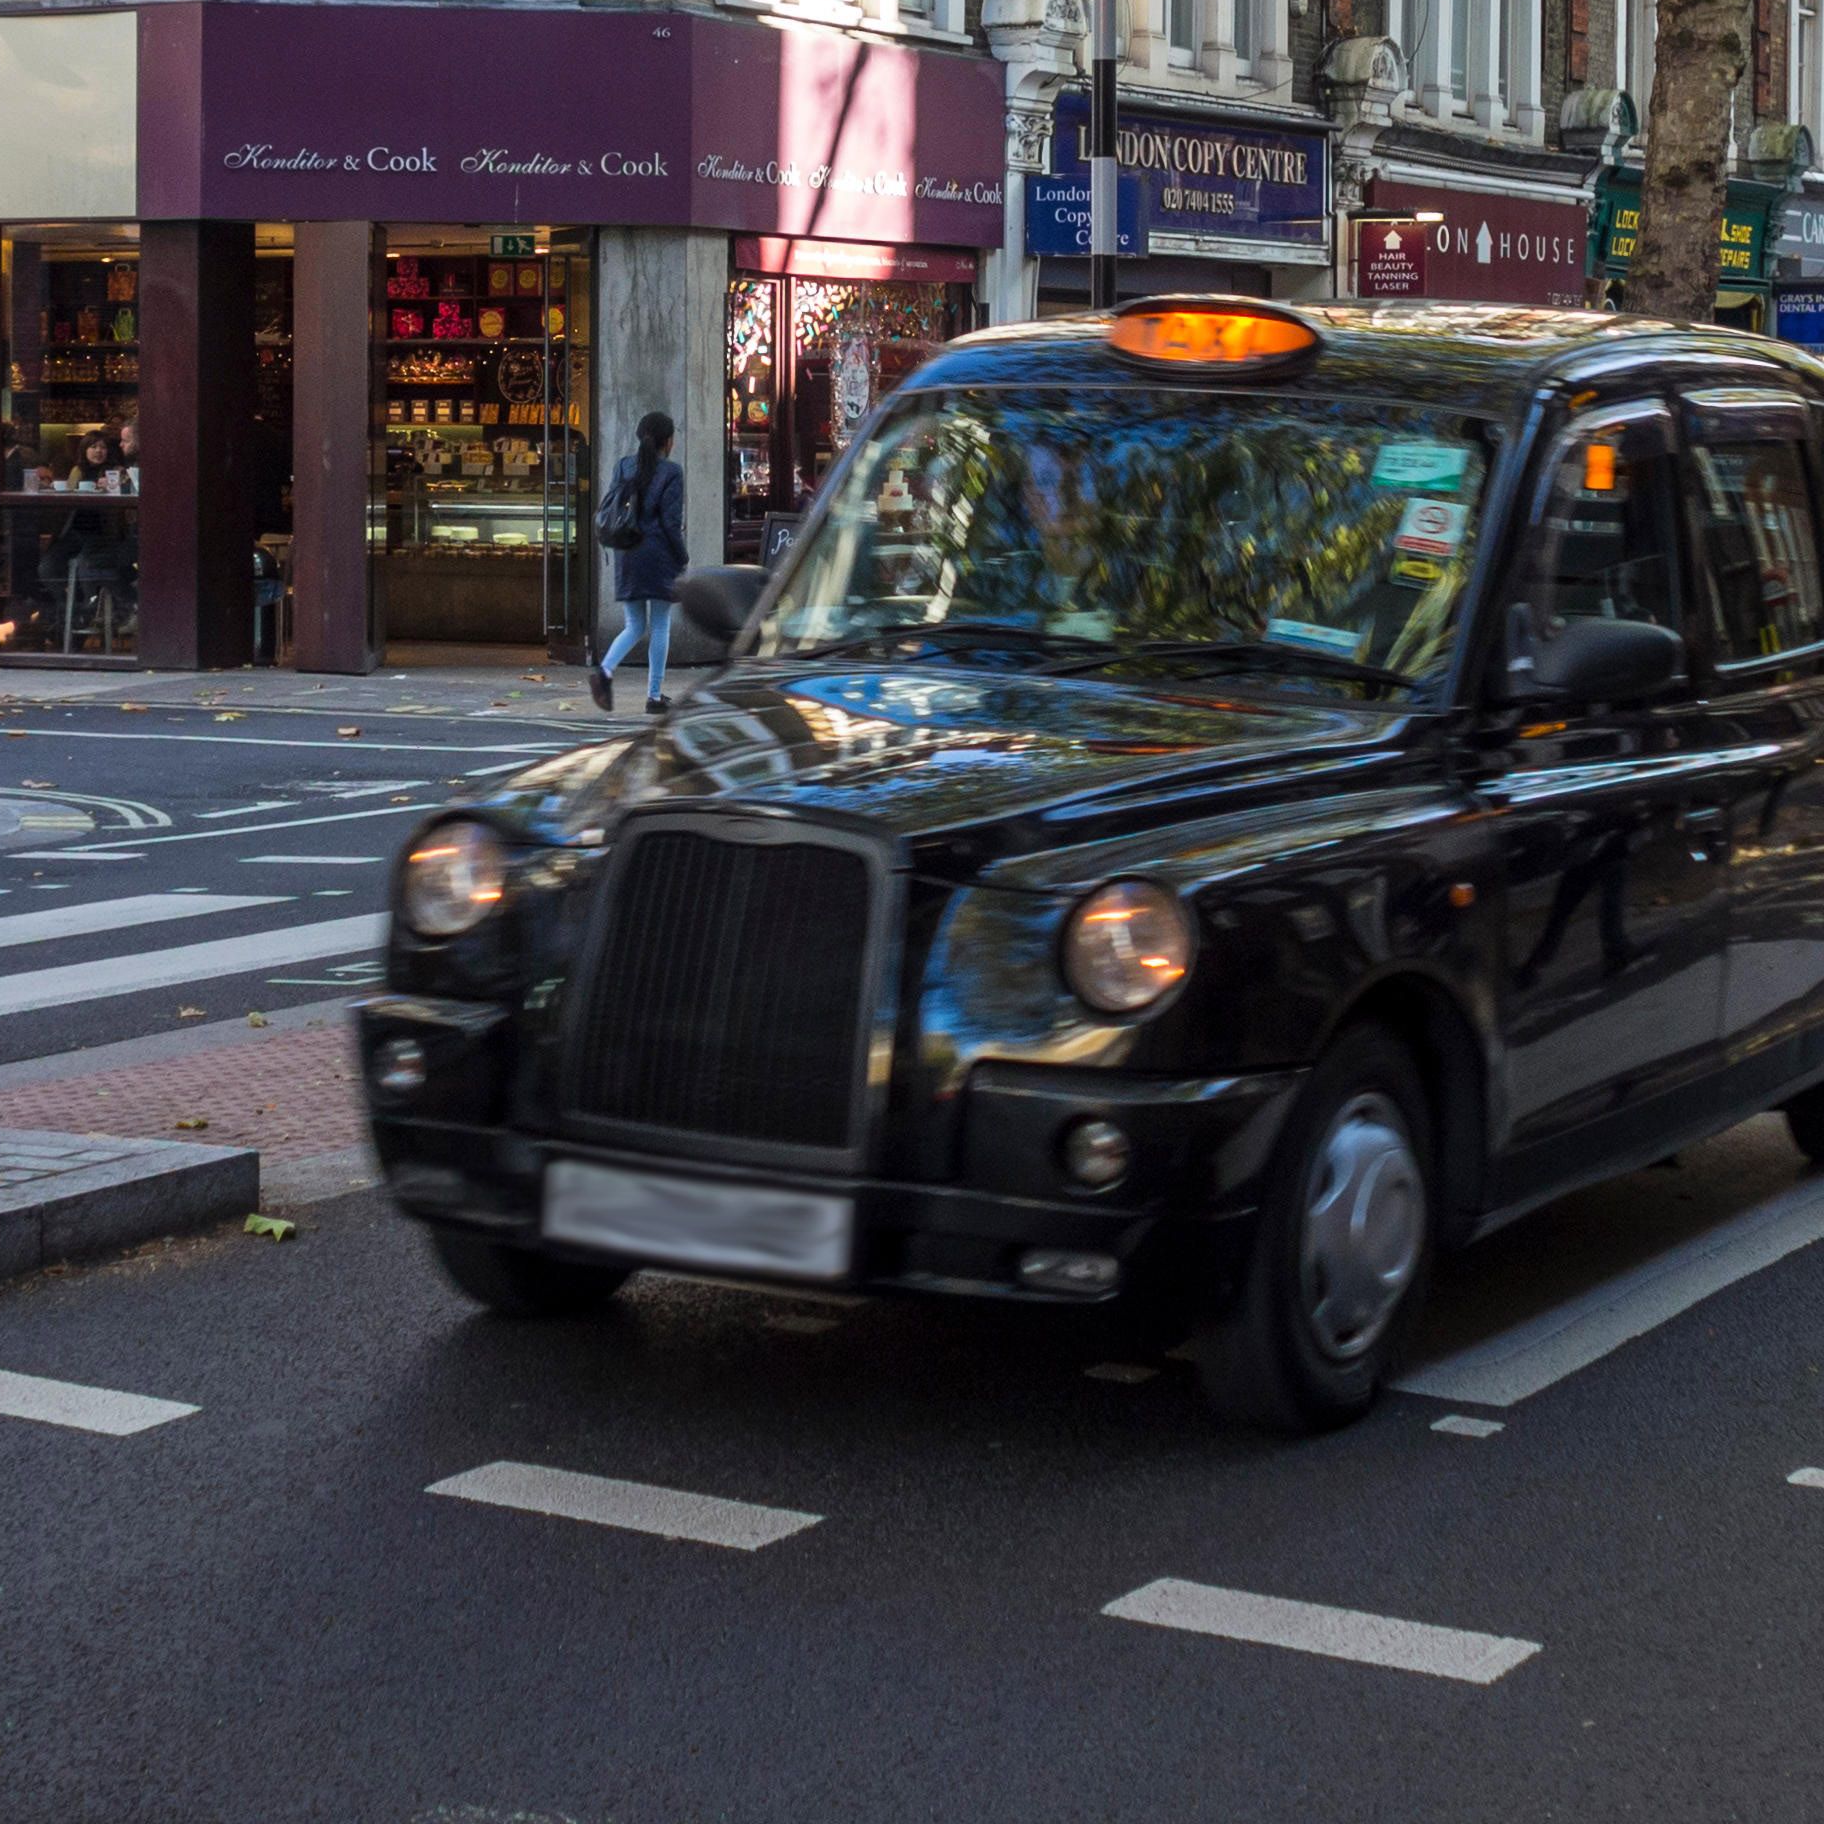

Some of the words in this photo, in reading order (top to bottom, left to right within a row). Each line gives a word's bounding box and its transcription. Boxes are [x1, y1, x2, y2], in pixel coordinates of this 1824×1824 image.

[224, 143, 338, 171] Konditor
[343, 154, 361, 171] &
[366, 147, 438, 173] Cook
[460, 148, 573, 175] Konditor
[577, 159, 593, 176] &
[600, 151, 670, 177] Cook
[1078, 126, 1169, 171] LNDON
[1174, 136, 1228, 177] COPY
[1232, 144, 1308, 185] CENTRE
[697, 154, 754, 181] Konditor
[755, 171, 764, 183] &
[766, 161, 802, 188] Cook
[915, 176, 964, 202] Konditor
[964, 190, 972, 202] &
[973, 181, 1003, 205] Cook
[1163, 188, 1183, 211] 020
[1184, 189, 1210, 212] 7404
[1212, 192, 1236, 215] 1555
[1054, 207, 1093, 227] Copy
[1731, 224, 1753, 244] SHOE
[1427, 224, 1469, 255] ON
[1500, 232, 1575, 265] HOUSE
[1370, 262, 1414, 271] BEAUTY
[1378, 252, 1406, 261] HAIR
[1367, 272, 1418, 281] TANNING
[1374, 282, 1409, 290] LASER
[1779, 294, 1813, 303] GRAY'S
[1779, 303, 1817, 313] DENTAL
